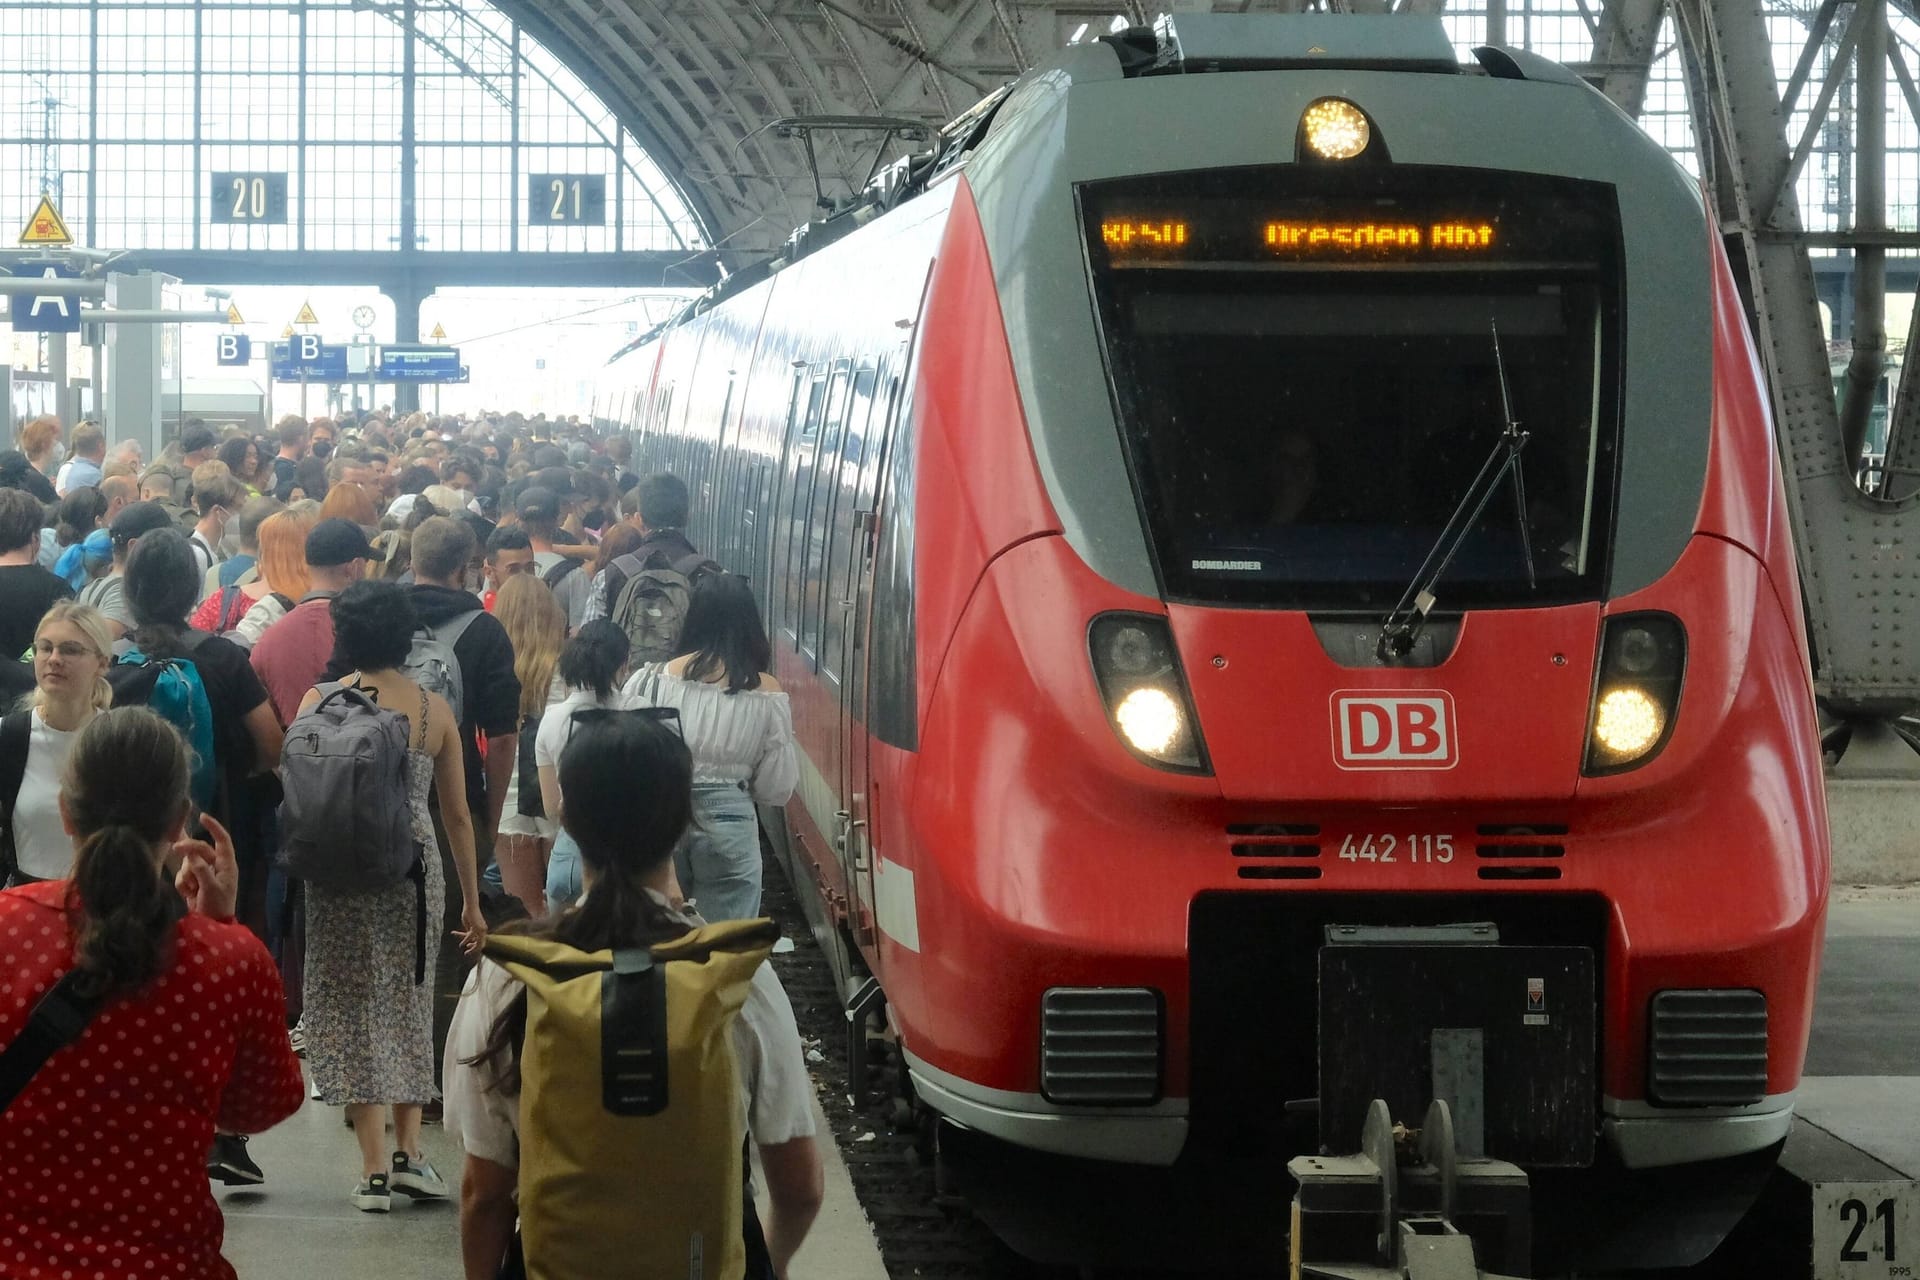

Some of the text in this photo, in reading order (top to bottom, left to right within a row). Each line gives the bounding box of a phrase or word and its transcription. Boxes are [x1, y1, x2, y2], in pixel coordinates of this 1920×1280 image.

[232, 177, 265, 218] 20
[551, 179, 580, 219] 21
[29, 266, 70, 317] A
[220, 335, 239, 360] B
[301, 335, 319, 360] B
[1191, 560, 1262, 571] BOMBARDIER
[1346, 703, 1442, 755] DB
[1338, 833, 1455, 864] 442 115
[1839, 1198, 1896, 1262] 21
[1888, 1266, 1912, 1277] 1995
